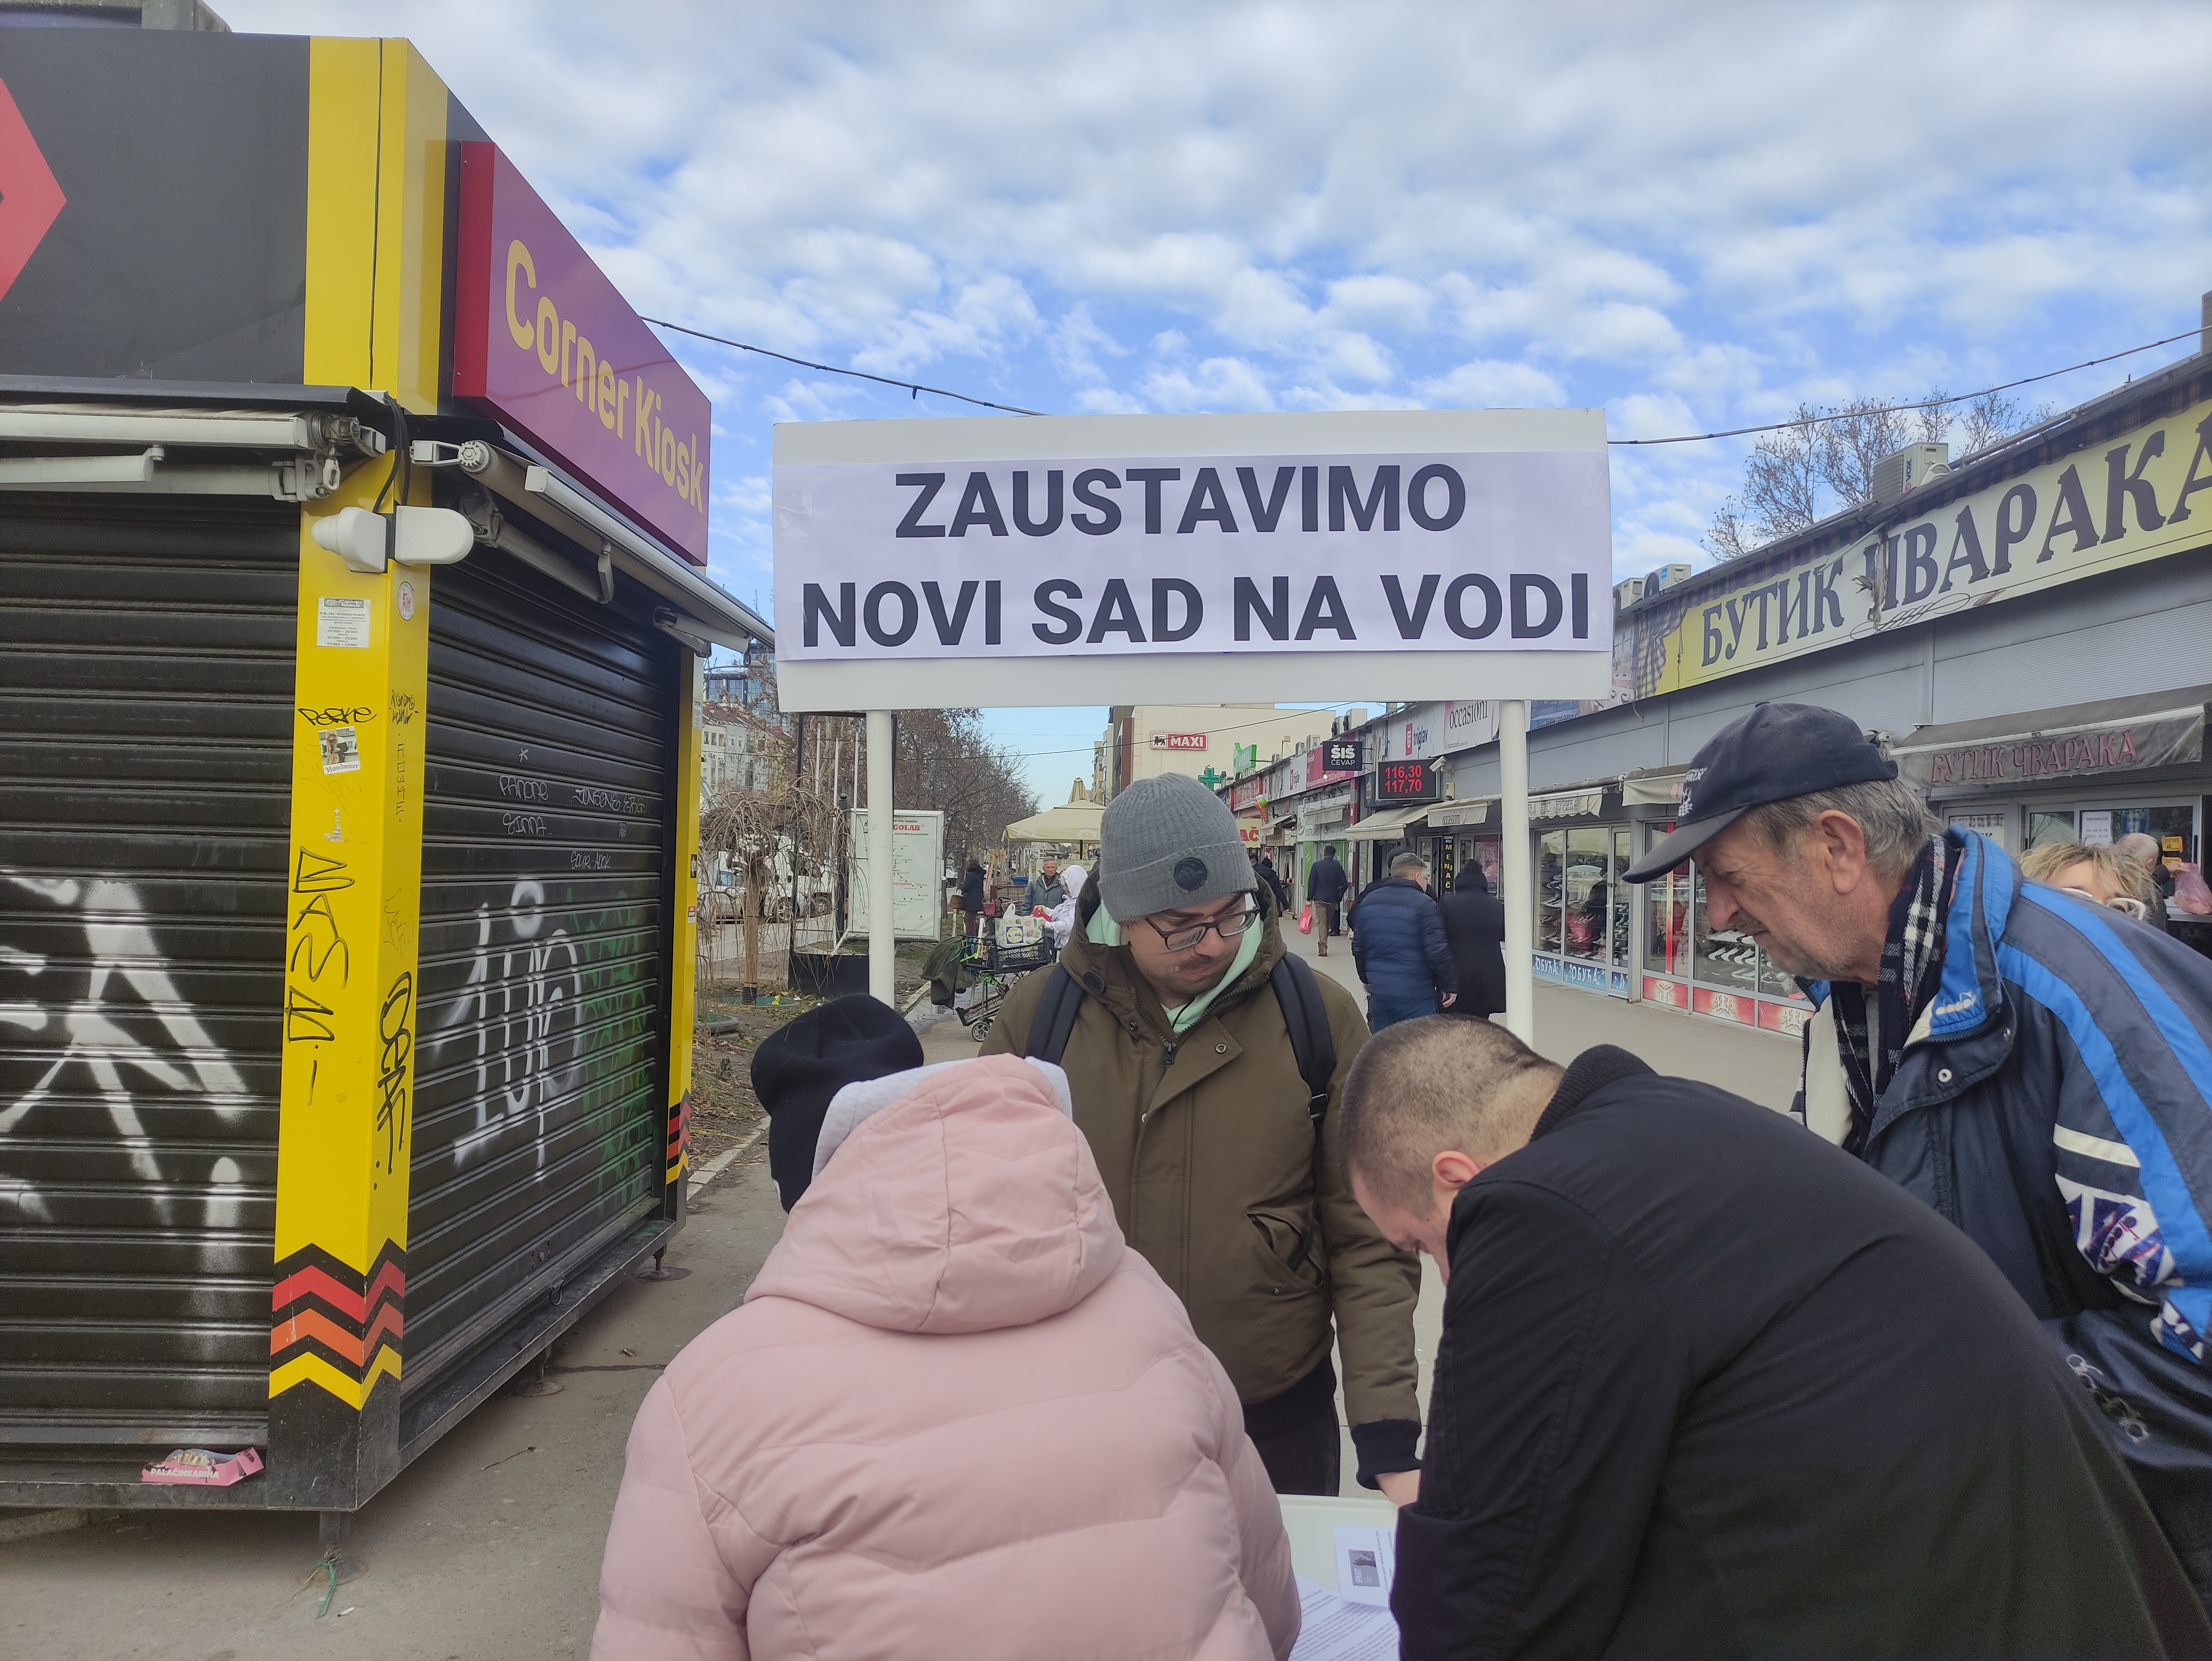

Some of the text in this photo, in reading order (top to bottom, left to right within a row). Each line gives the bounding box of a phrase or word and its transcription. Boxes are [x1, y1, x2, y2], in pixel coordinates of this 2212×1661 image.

[505, 239, 704, 514] Corner Kiosk
[896, 464, 1465, 538] ZAUSTAVIMO
[804, 574, 1588, 647] NOVI SAD NA VODI
[1702, 556, 1844, 667] БУТИК
[1449, 700, 1487, 729] occasioni
[1171, 736, 1203, 747] MAXI
[1331, 744, 1355, 759] ŠIŠ
[1414, 725, 1428, 751] triglav
[1931, 730, 2137, 783] БУТИК ЧВАРАКА
[1385, 765, 1422, 780] 116,30
[1385, 779, 1422, 794] 117,70
